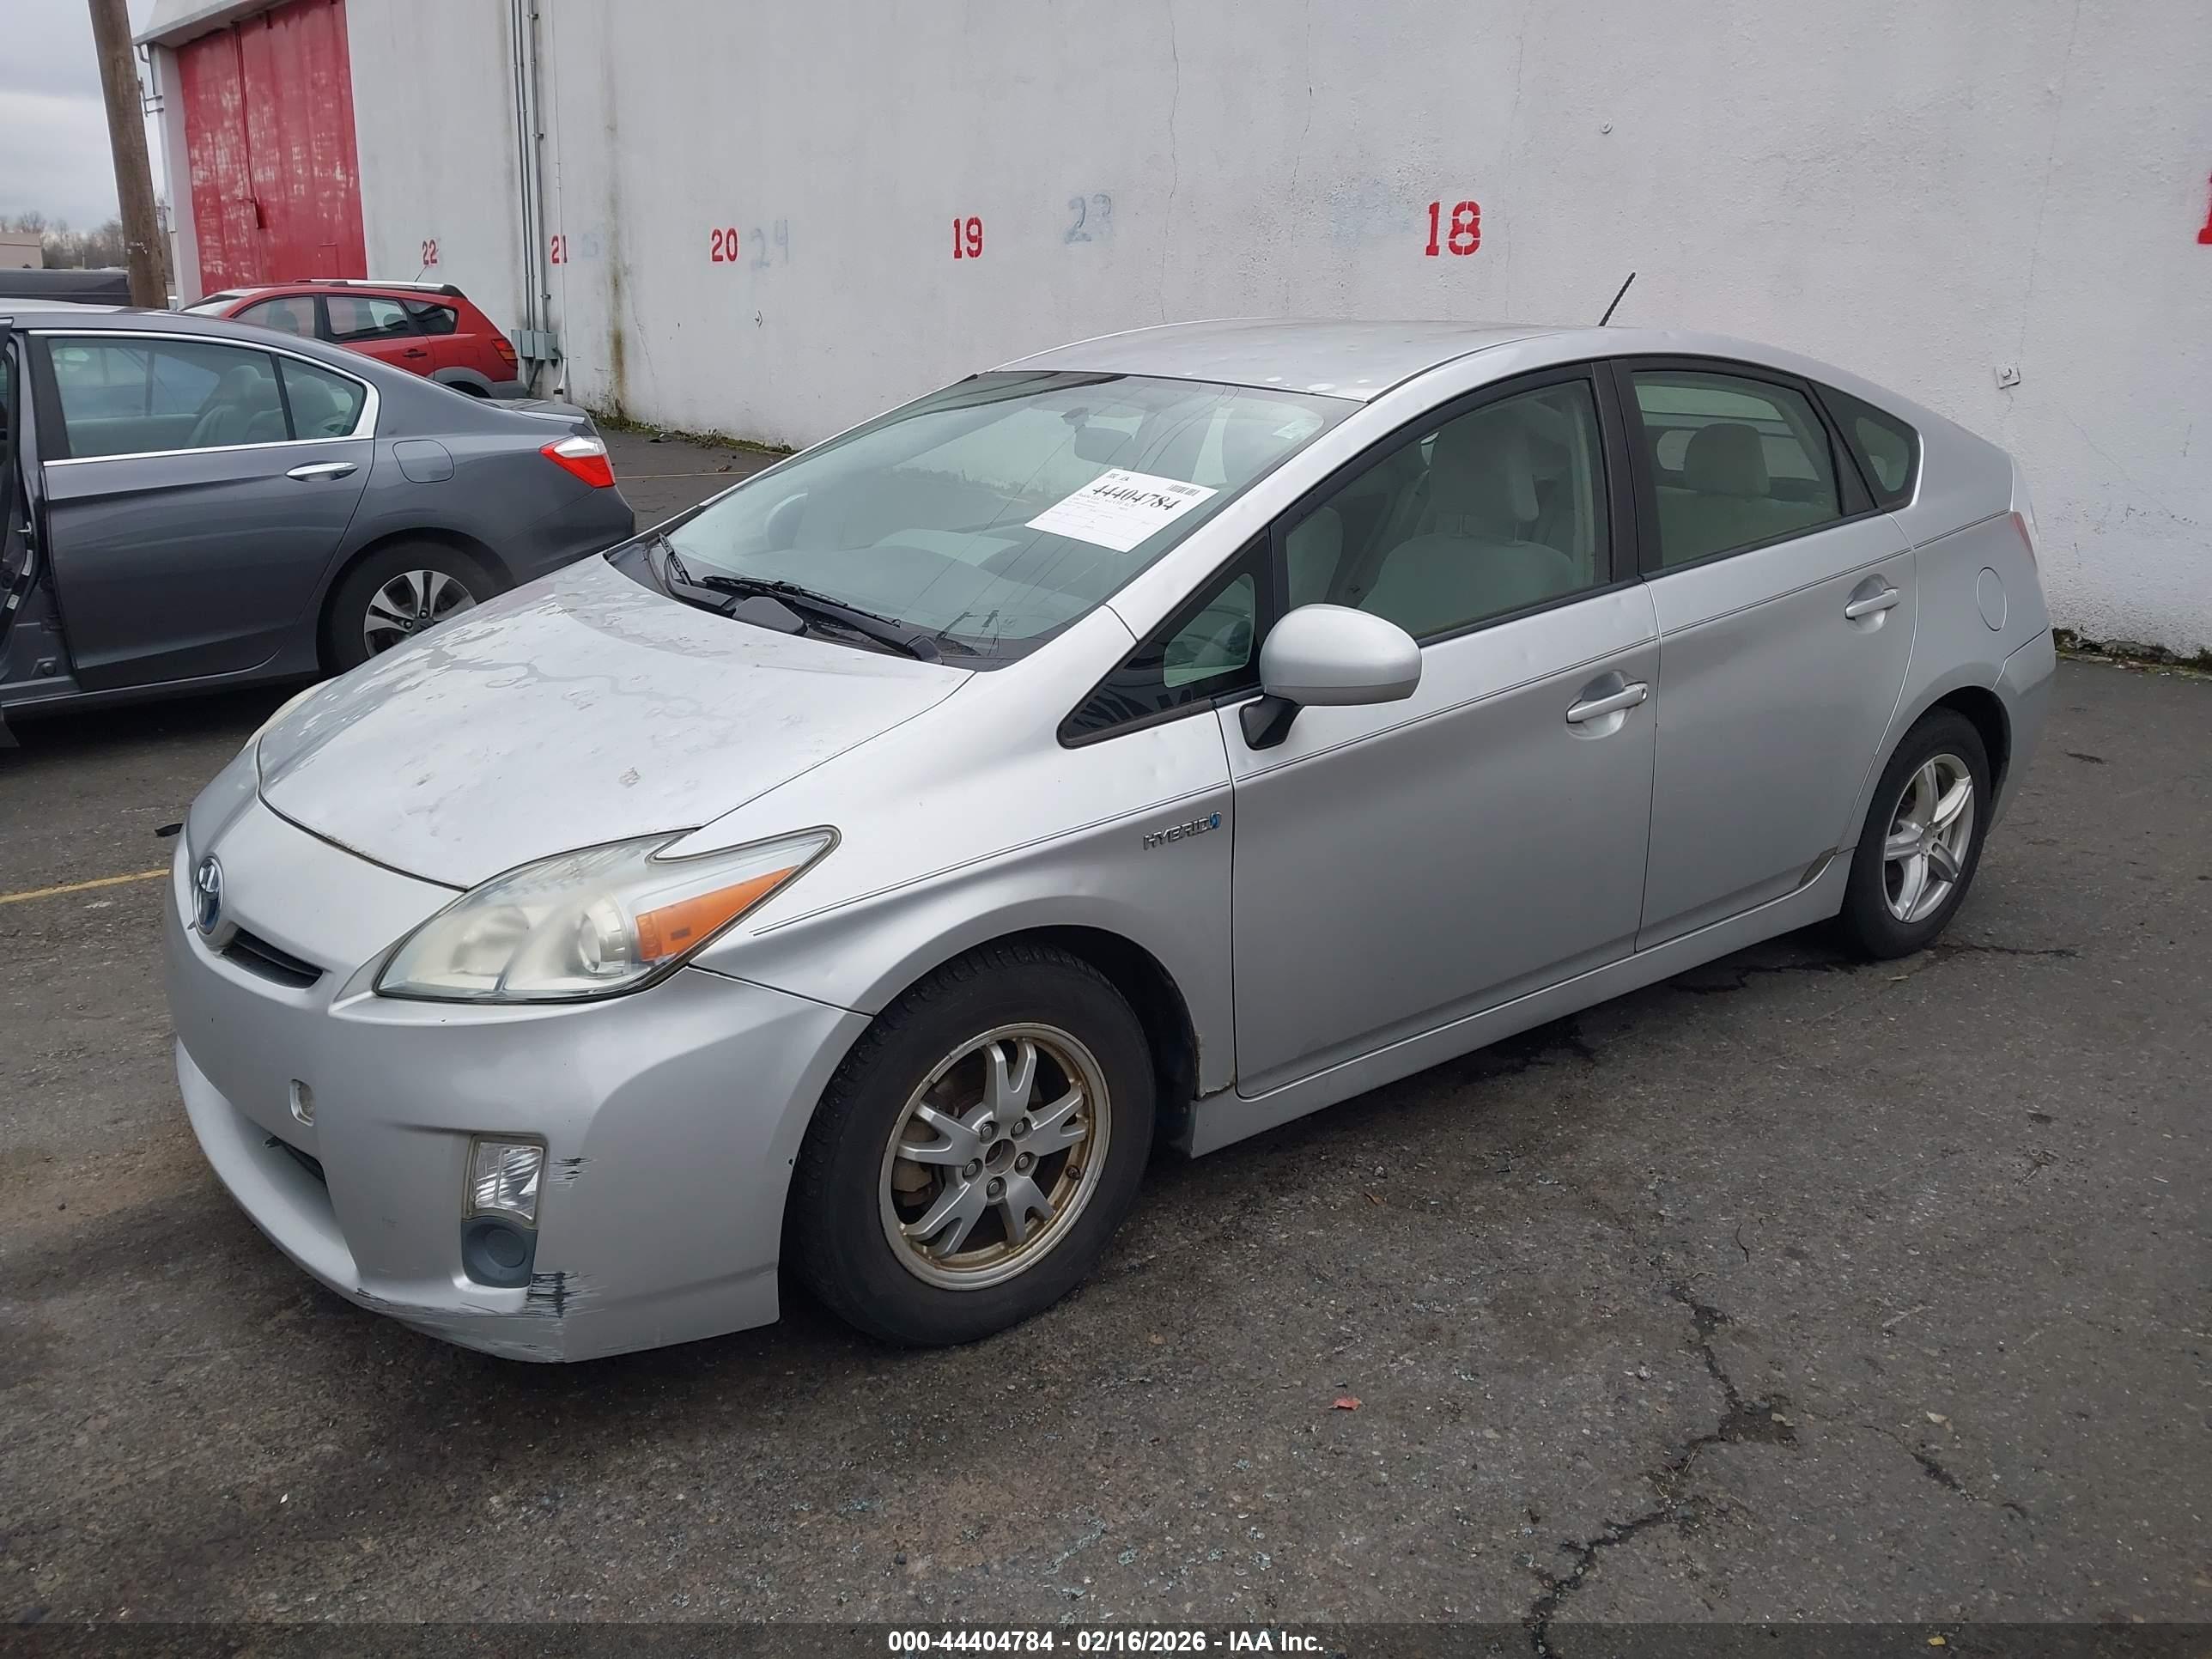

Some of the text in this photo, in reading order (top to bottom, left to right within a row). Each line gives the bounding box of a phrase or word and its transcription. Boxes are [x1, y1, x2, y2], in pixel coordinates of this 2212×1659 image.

[711, 228, 738, 262] 20
[953, 216, 983, 258] 19
[1425, 201, 1481, 256] 18
[422, 239, 438, 265] 22
[550, 234, 568, 264] 21
[1092, 483, 1182, 511] 44404784
[1143, 817, 1211, 850] HYBRID
